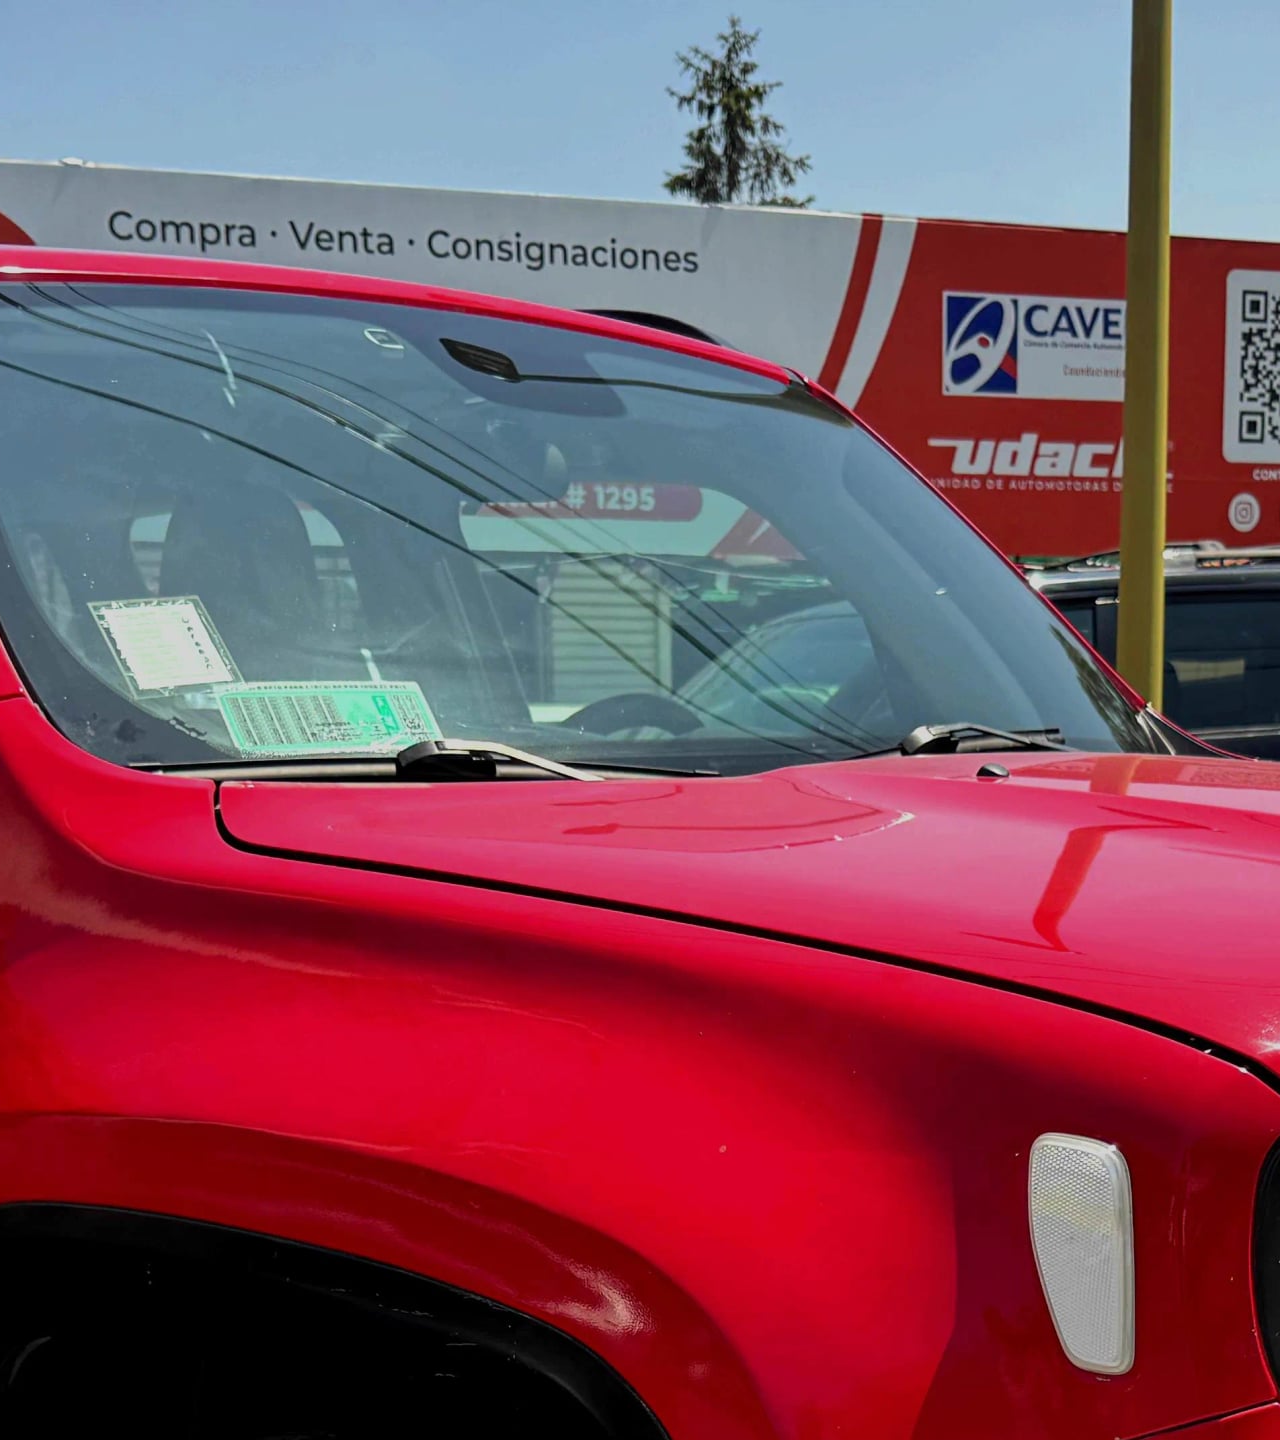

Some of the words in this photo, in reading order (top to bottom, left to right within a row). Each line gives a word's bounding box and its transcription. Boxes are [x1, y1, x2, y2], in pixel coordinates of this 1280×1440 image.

[108, 210, 257, 253] Compra
[289, 220, 395, 256] Venta
[427, 229, 700, 274] Consignaciones
[593, 484, 656, 512] 1295
